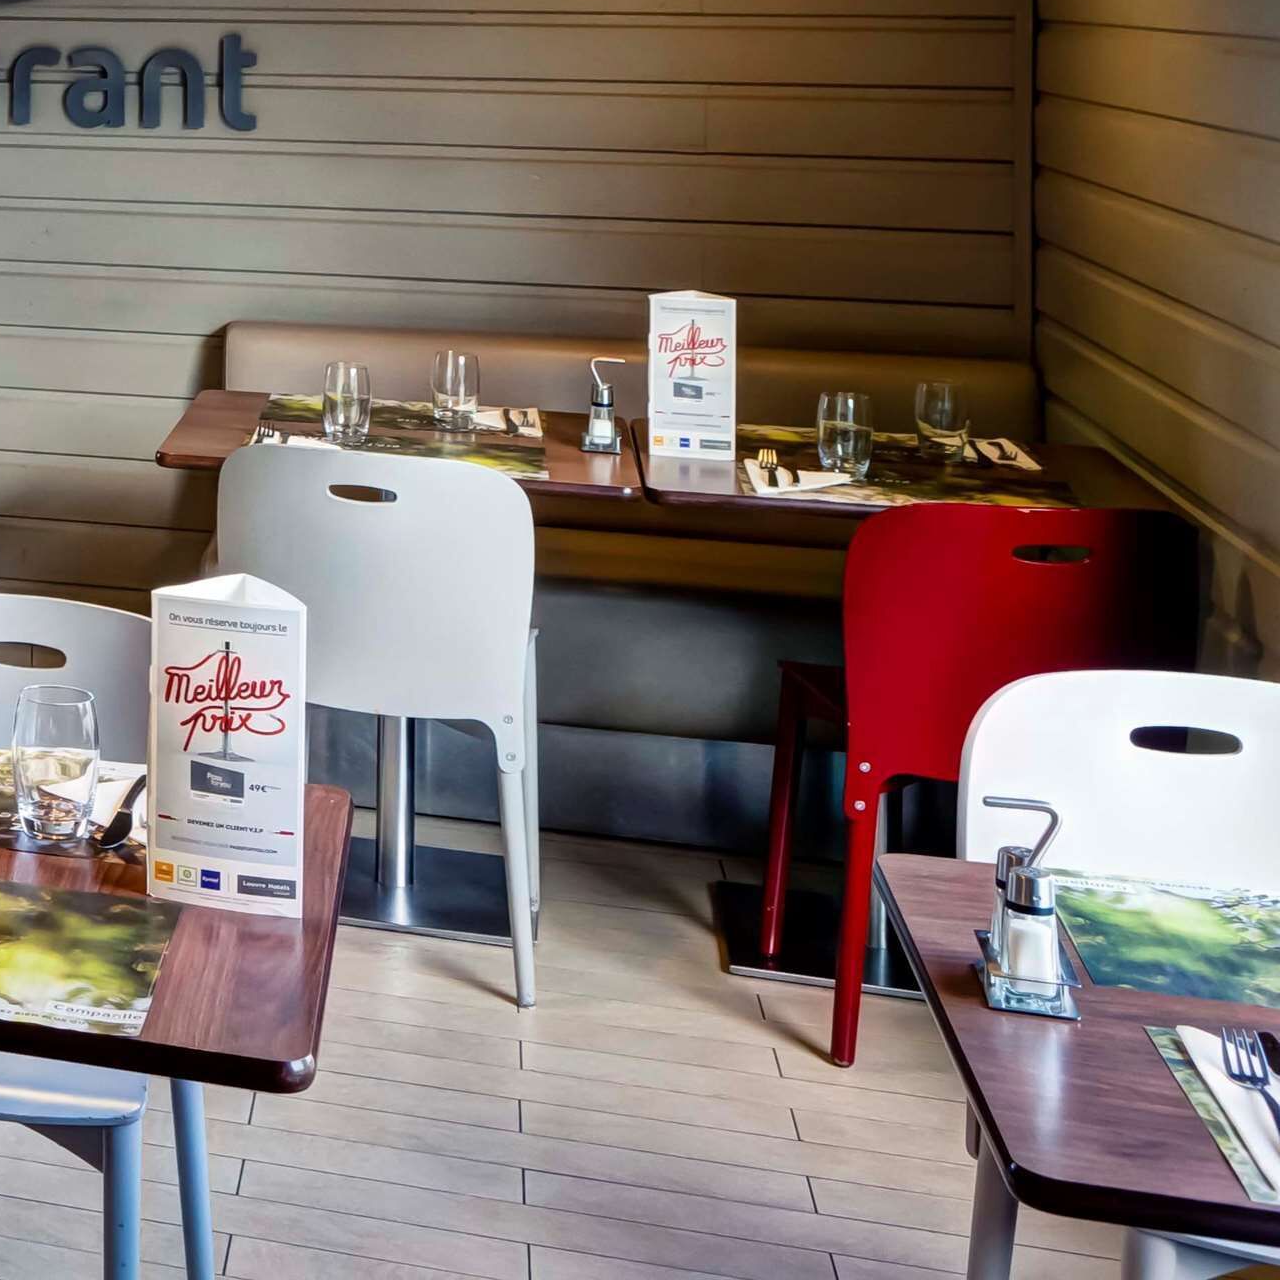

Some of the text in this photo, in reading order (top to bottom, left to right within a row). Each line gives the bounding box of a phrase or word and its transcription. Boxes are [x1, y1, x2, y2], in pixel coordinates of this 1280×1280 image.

[657, 326, 727, 353] Meilleur
[667, 353, 725, 378] prix
[168, 613, 181, 622] On
[182, 615, 203, 624] vous
[239, 622, 277, 632] toujours
[164, 654, 290, 704] Meilleur
[180, 705, 285, 752] prix
